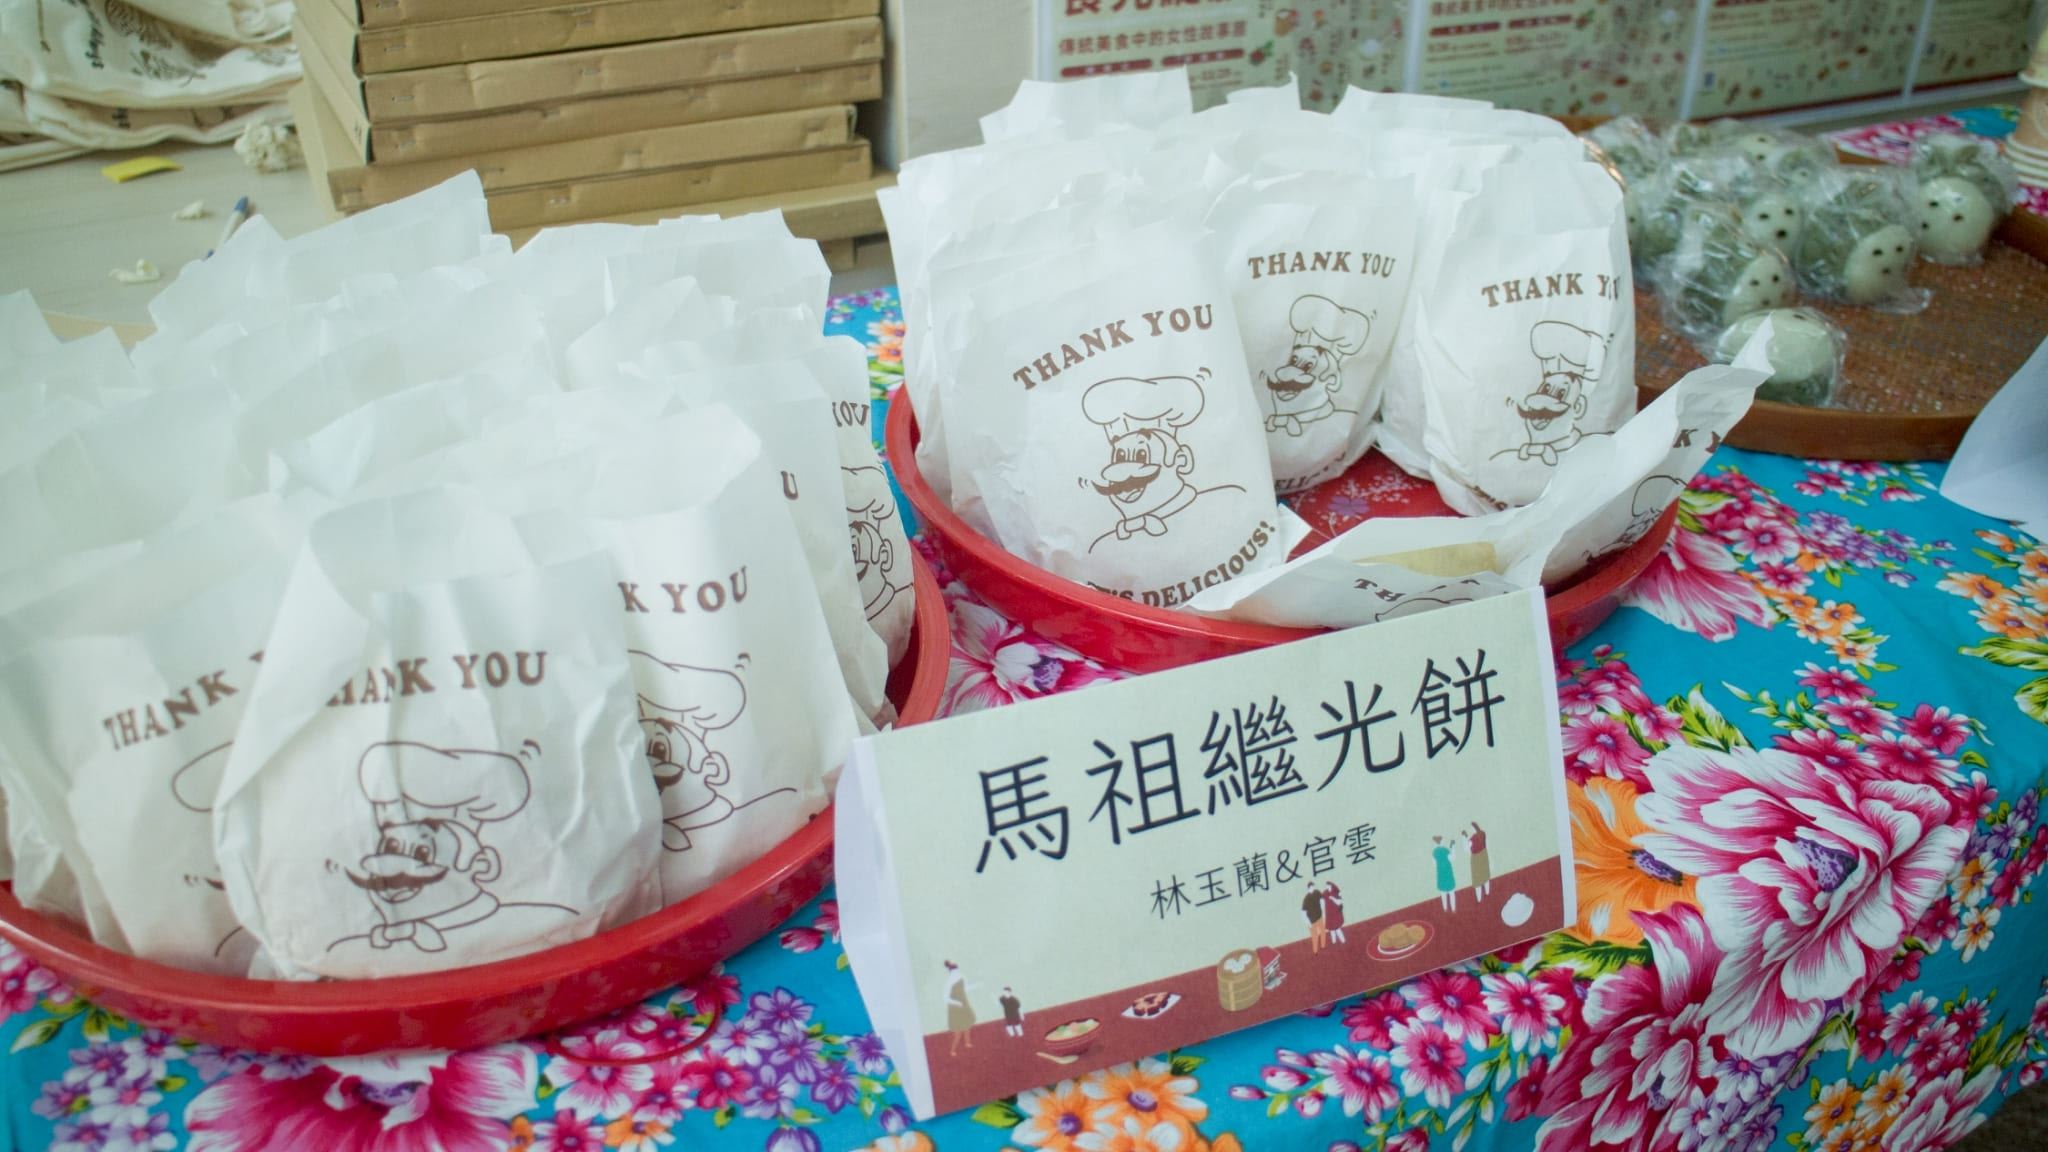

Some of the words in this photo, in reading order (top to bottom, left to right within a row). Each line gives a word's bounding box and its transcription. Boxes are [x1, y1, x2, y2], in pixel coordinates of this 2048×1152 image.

[1248, 251, 1350, 280] THANK
[1360, 252, 1396, 279] YOU
[1481, 273, 1584, 308] THANK
[1012, 319, 1134, 390] THANK
[1142, 304, 1214, 337] YOU
[661, 565, 748, 613] YOU
[453, 651, 547, 690] YOU
[103, 670, 239, 751] THANK
[976, 648, 1506, 874] 馬祖繼光餅
[1150, 823, 1377, 920] 林玉蘭&官雲
